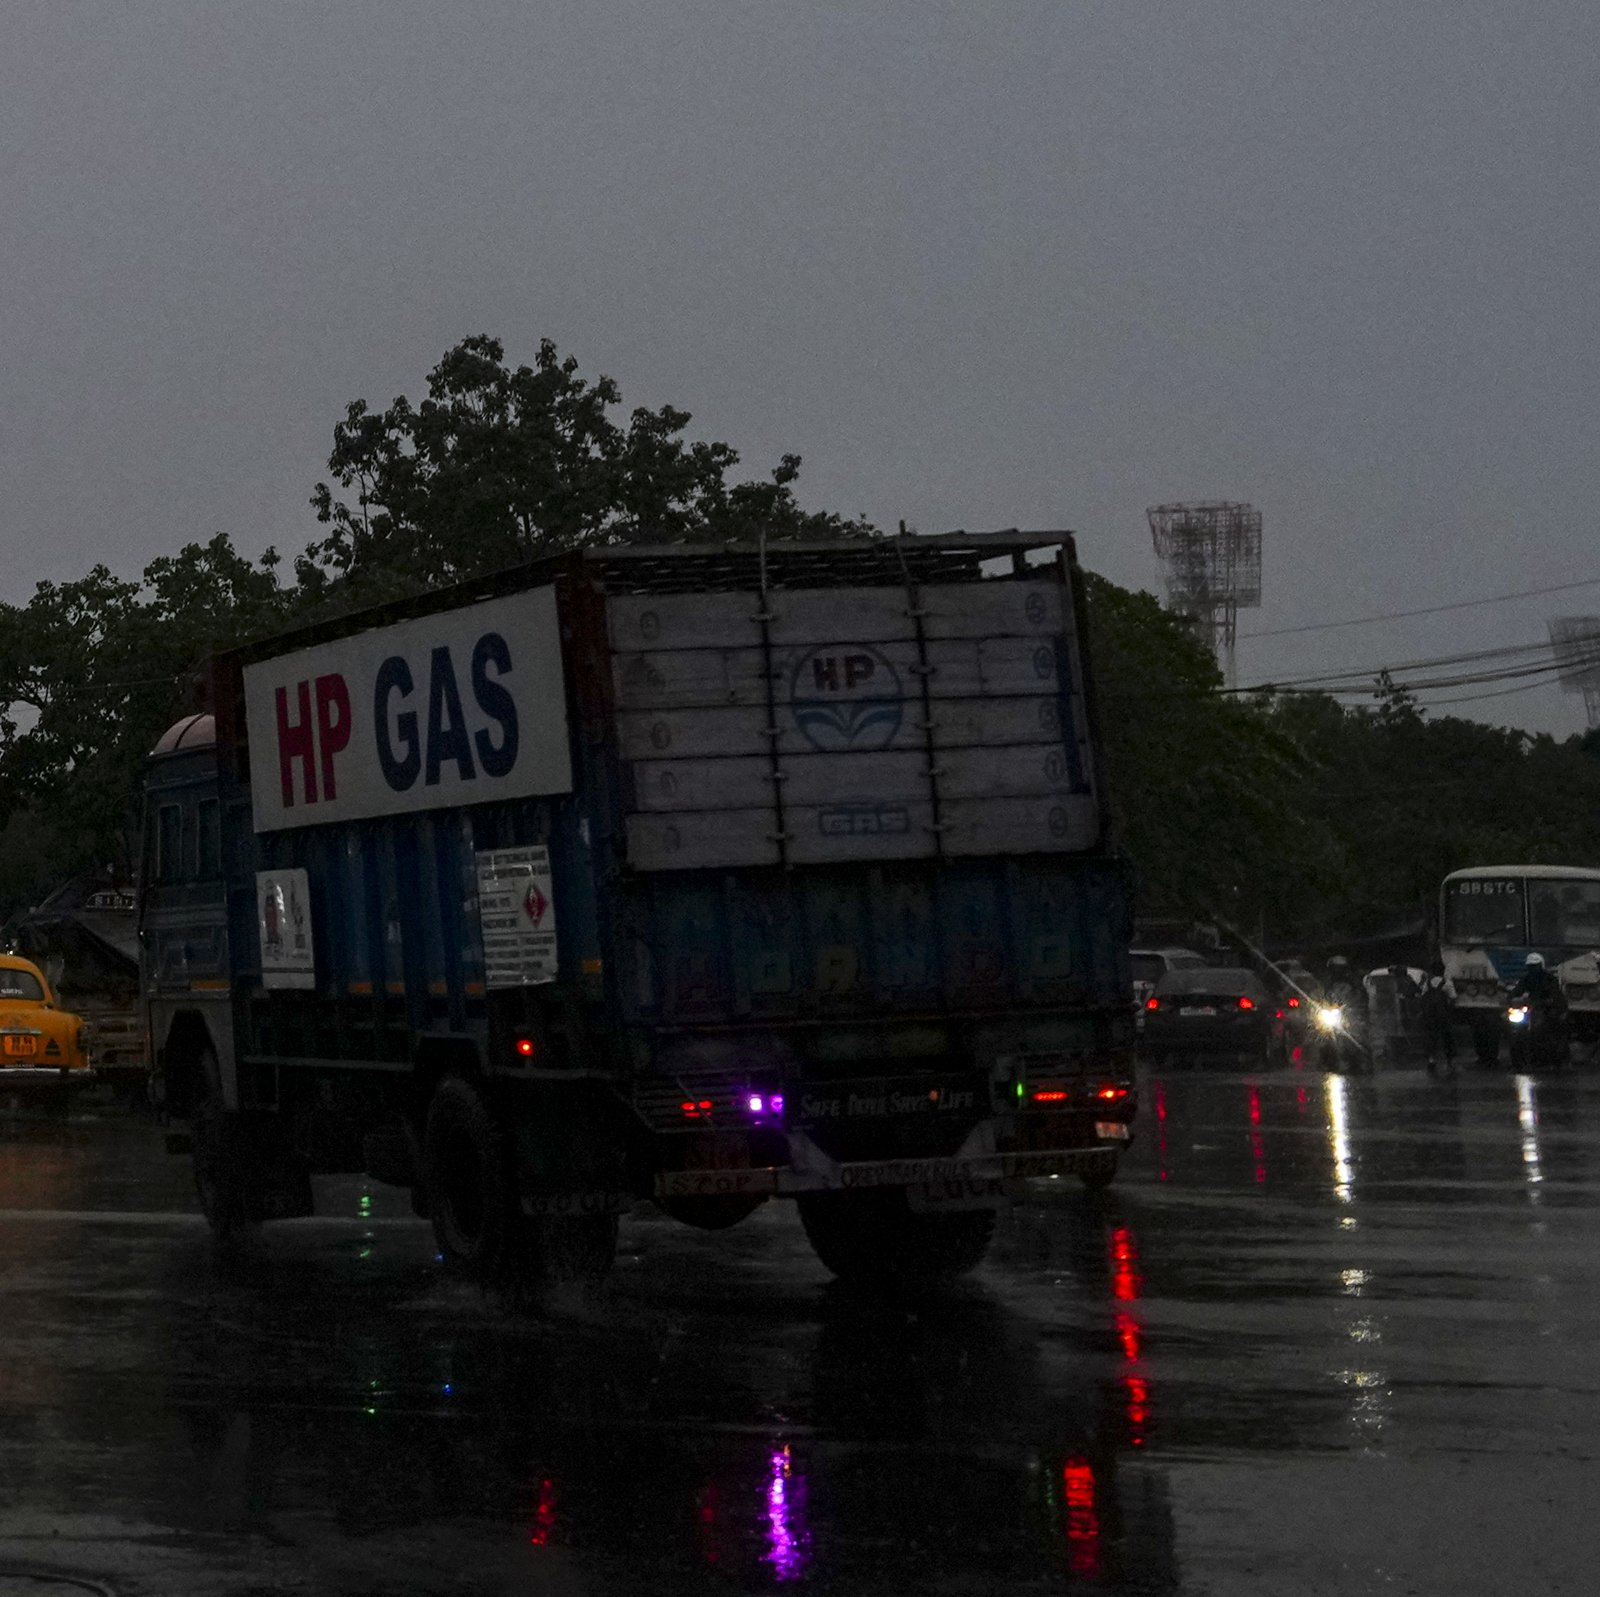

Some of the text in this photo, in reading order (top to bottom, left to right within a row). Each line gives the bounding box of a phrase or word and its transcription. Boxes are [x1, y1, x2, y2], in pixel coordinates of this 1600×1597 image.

[812, 654, 875, 692] HP
[275, 632, 520, 808] HP GAS
[830, 813, 904, 833] GAS
[937, 1088, 974, 1110] LIFE
